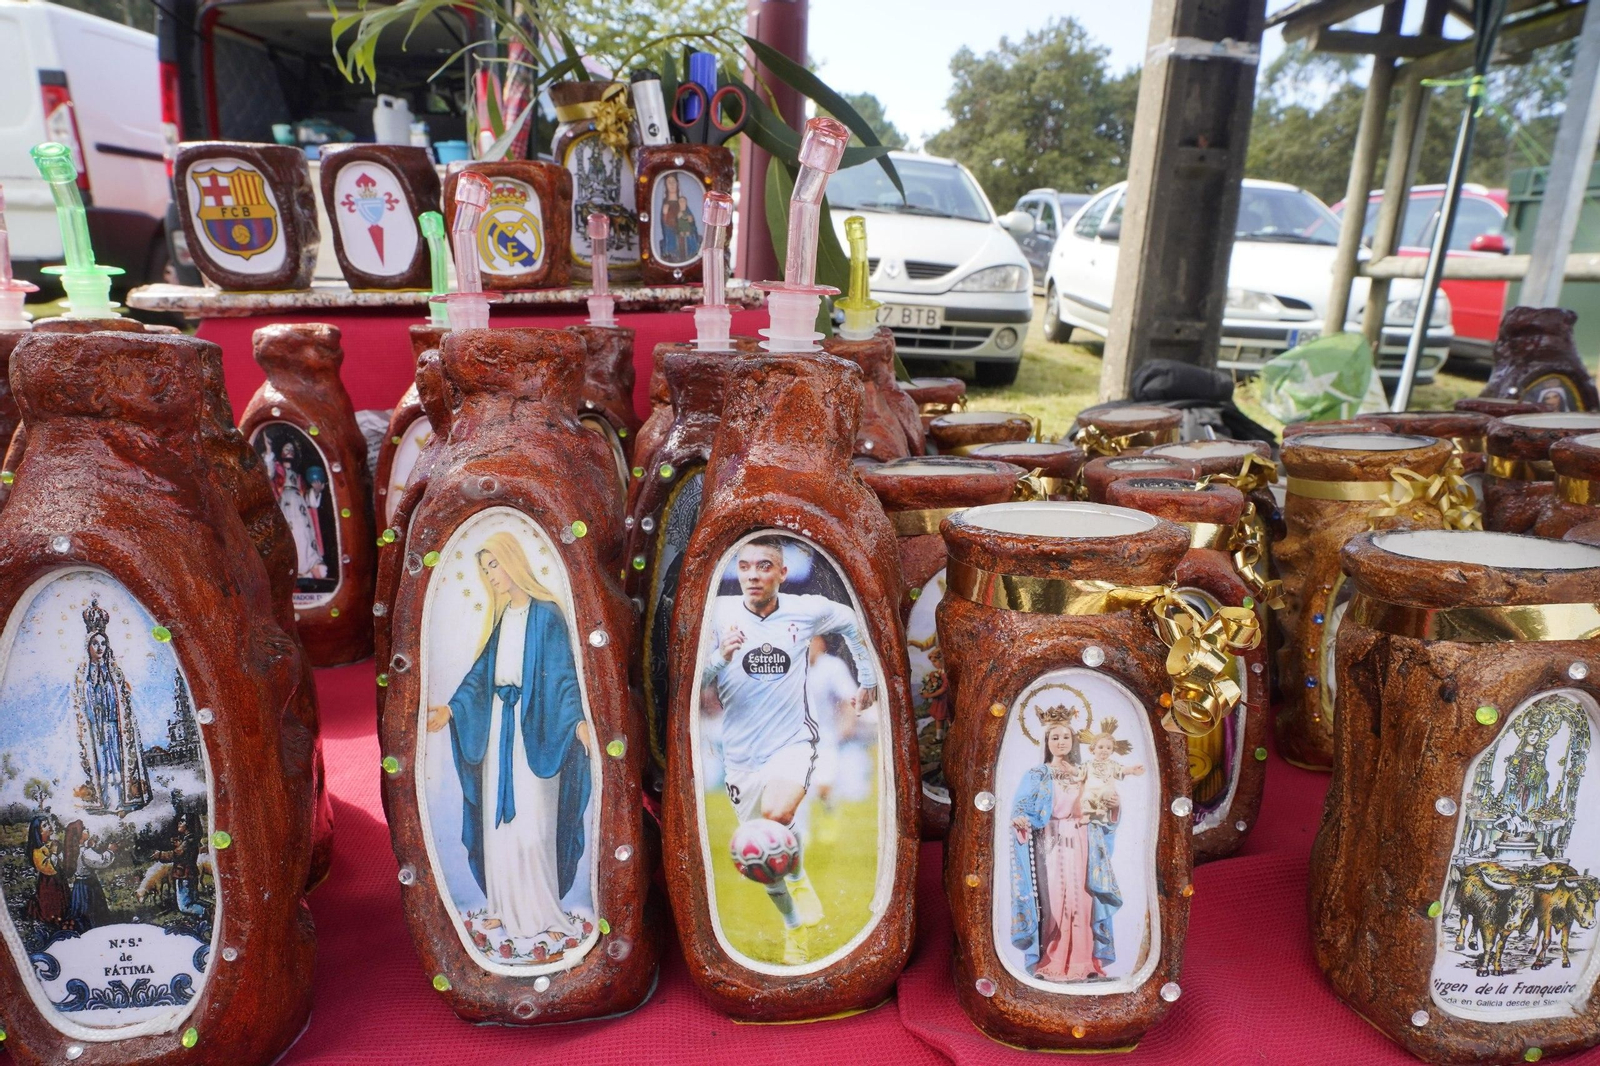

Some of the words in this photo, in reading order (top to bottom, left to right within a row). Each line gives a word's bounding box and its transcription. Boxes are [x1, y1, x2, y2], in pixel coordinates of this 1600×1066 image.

[901, 307, 937, 325] BTB
[748, 652, 786, 664] Estrella
[749, 663, 784, 674] Galicia
[119, 952, 133, 962] de
[104, 964, 155, 976] FÁTIMA
[1475, 983, 1494, 995] de
[1494, 983, 1509, 995] la
[1461, 998, 1473, 1006] en
[1476, 999, 1503, 1007] Galicia
[1506, 999, 1530, 1007] desde
